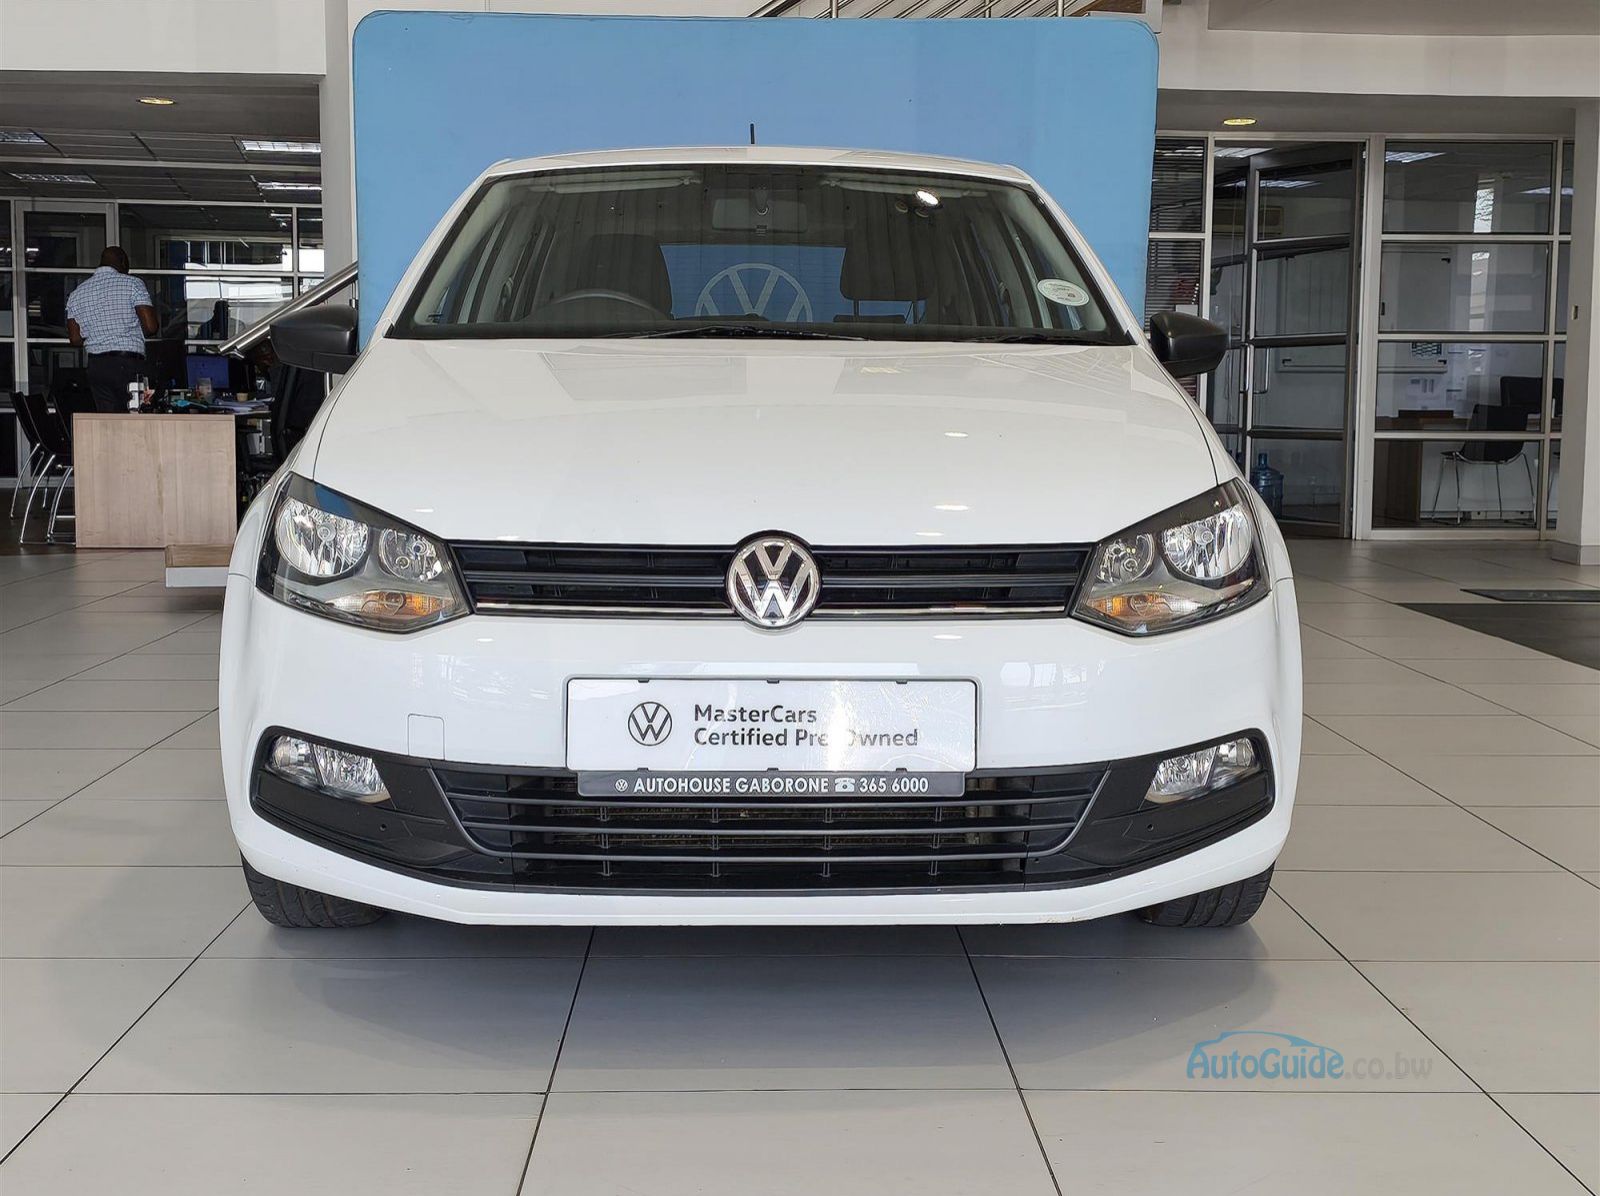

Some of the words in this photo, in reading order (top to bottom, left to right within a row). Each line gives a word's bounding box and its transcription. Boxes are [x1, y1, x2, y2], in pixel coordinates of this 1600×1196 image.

[727, 537, 820, 627] VW
[694, 704, 817, 723] MasterCars
[628, 702, 672, 746] VW
[694, 728, 788, 746] Certified
[633, 778, 731, 793] AUTOHOUSE
[735, 777, 829, 793] GABORONE
[859, 777, 887, 793] 365
[891, 777, 929, 793] 6000
